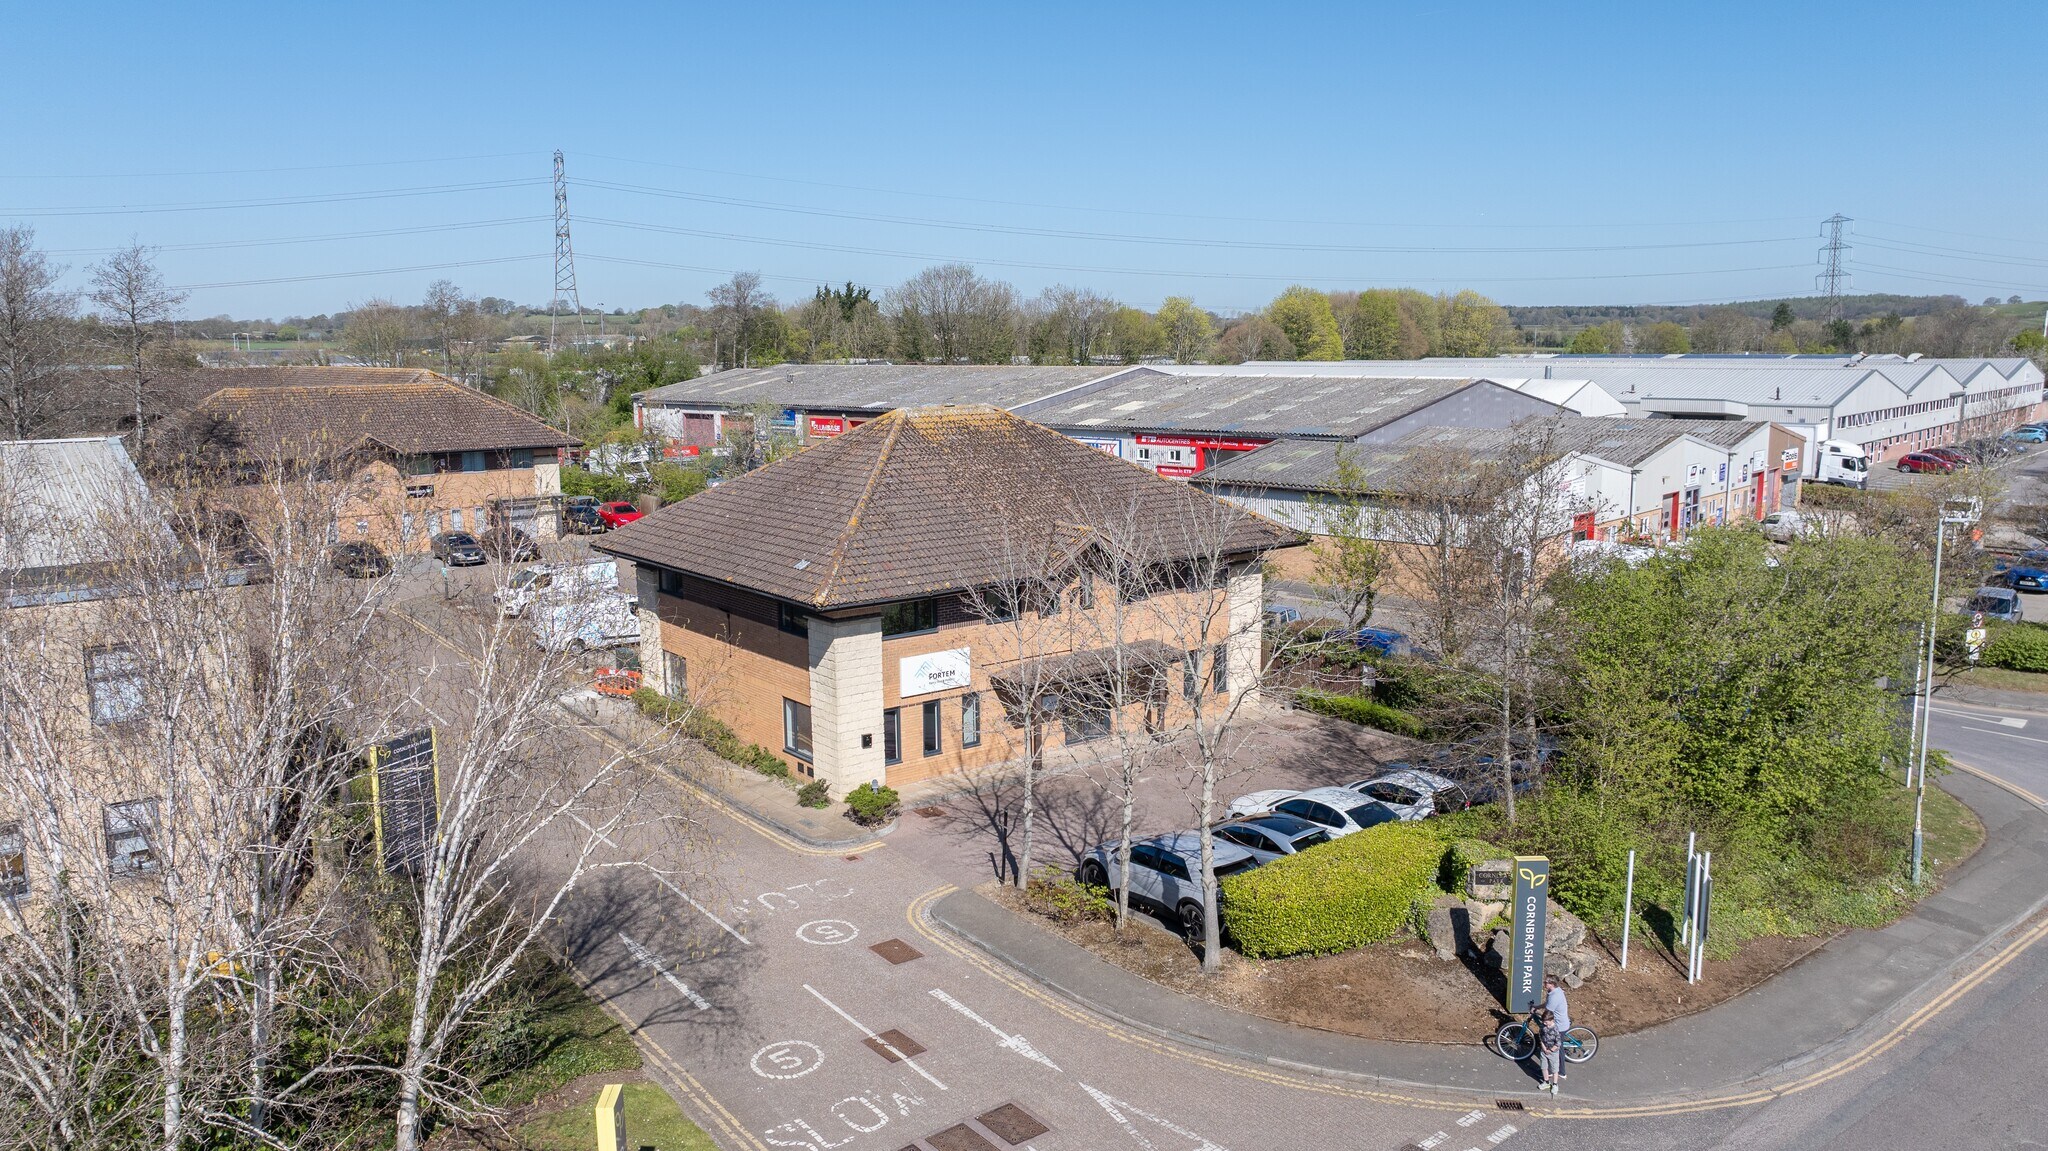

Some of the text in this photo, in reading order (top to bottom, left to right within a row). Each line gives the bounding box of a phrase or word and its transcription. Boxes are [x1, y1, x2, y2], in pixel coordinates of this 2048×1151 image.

[813, 424, 841, 432] PLUMBASE
[1157, 437, 1191, 445] AUTOCENTRES
[928, 669, 956, 680] FORTEM
[419, 737, 431, 745] PARK
[1522, 896, 1537, 994] CORNBRASH PARK
